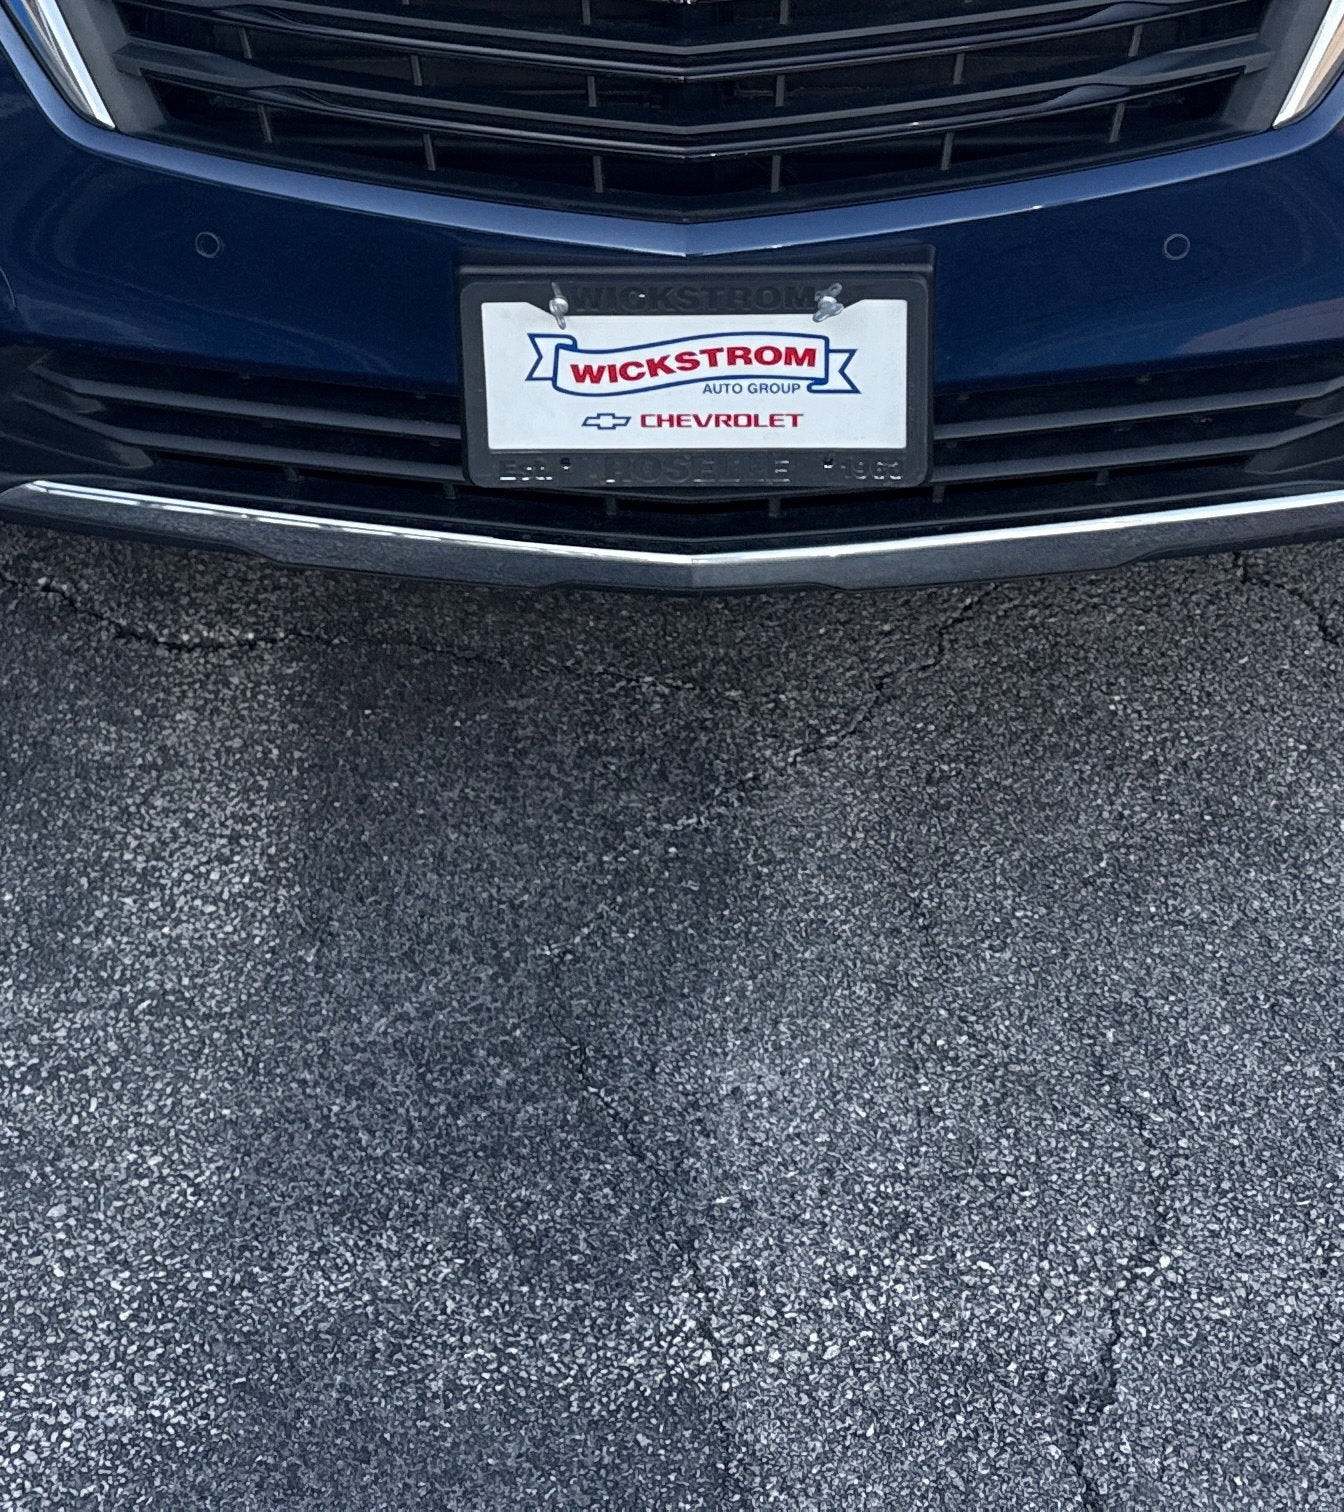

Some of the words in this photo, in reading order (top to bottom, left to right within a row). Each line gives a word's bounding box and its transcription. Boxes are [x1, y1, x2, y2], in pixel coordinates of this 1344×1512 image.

[570, 345, 817, 384] WICKSTROM
[702, 382, 743, 395] AUTO
[747, 382, 801, 395] GROUP
[640, 413, 805, 428] CHEVROLET
